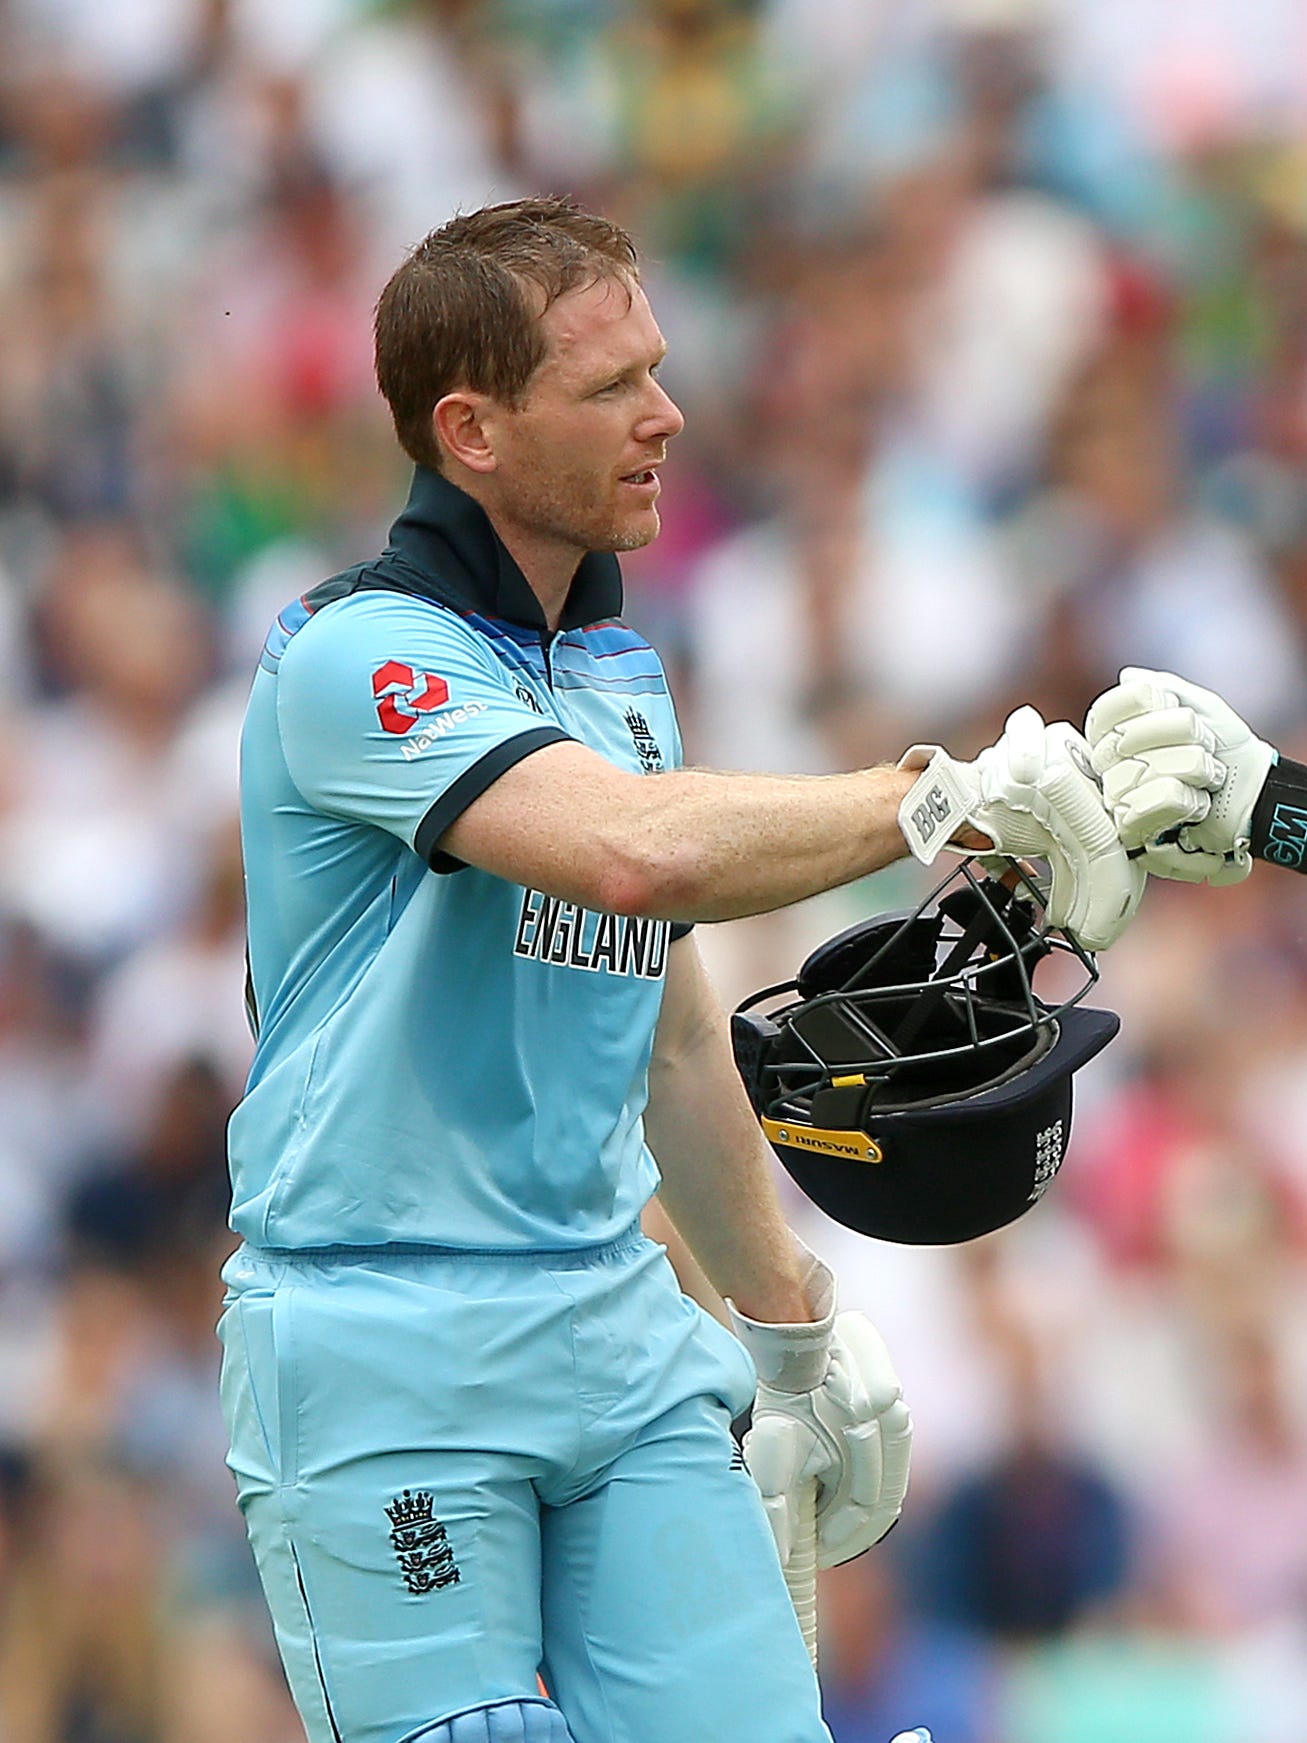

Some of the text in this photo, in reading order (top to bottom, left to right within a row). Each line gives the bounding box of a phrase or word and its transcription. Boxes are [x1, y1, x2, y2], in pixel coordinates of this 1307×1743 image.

[400, 701, 488, 761] NatWest
[513, 887, 671, 981] ENGLAND
[795, 1135, 860, 1155] MASURI
